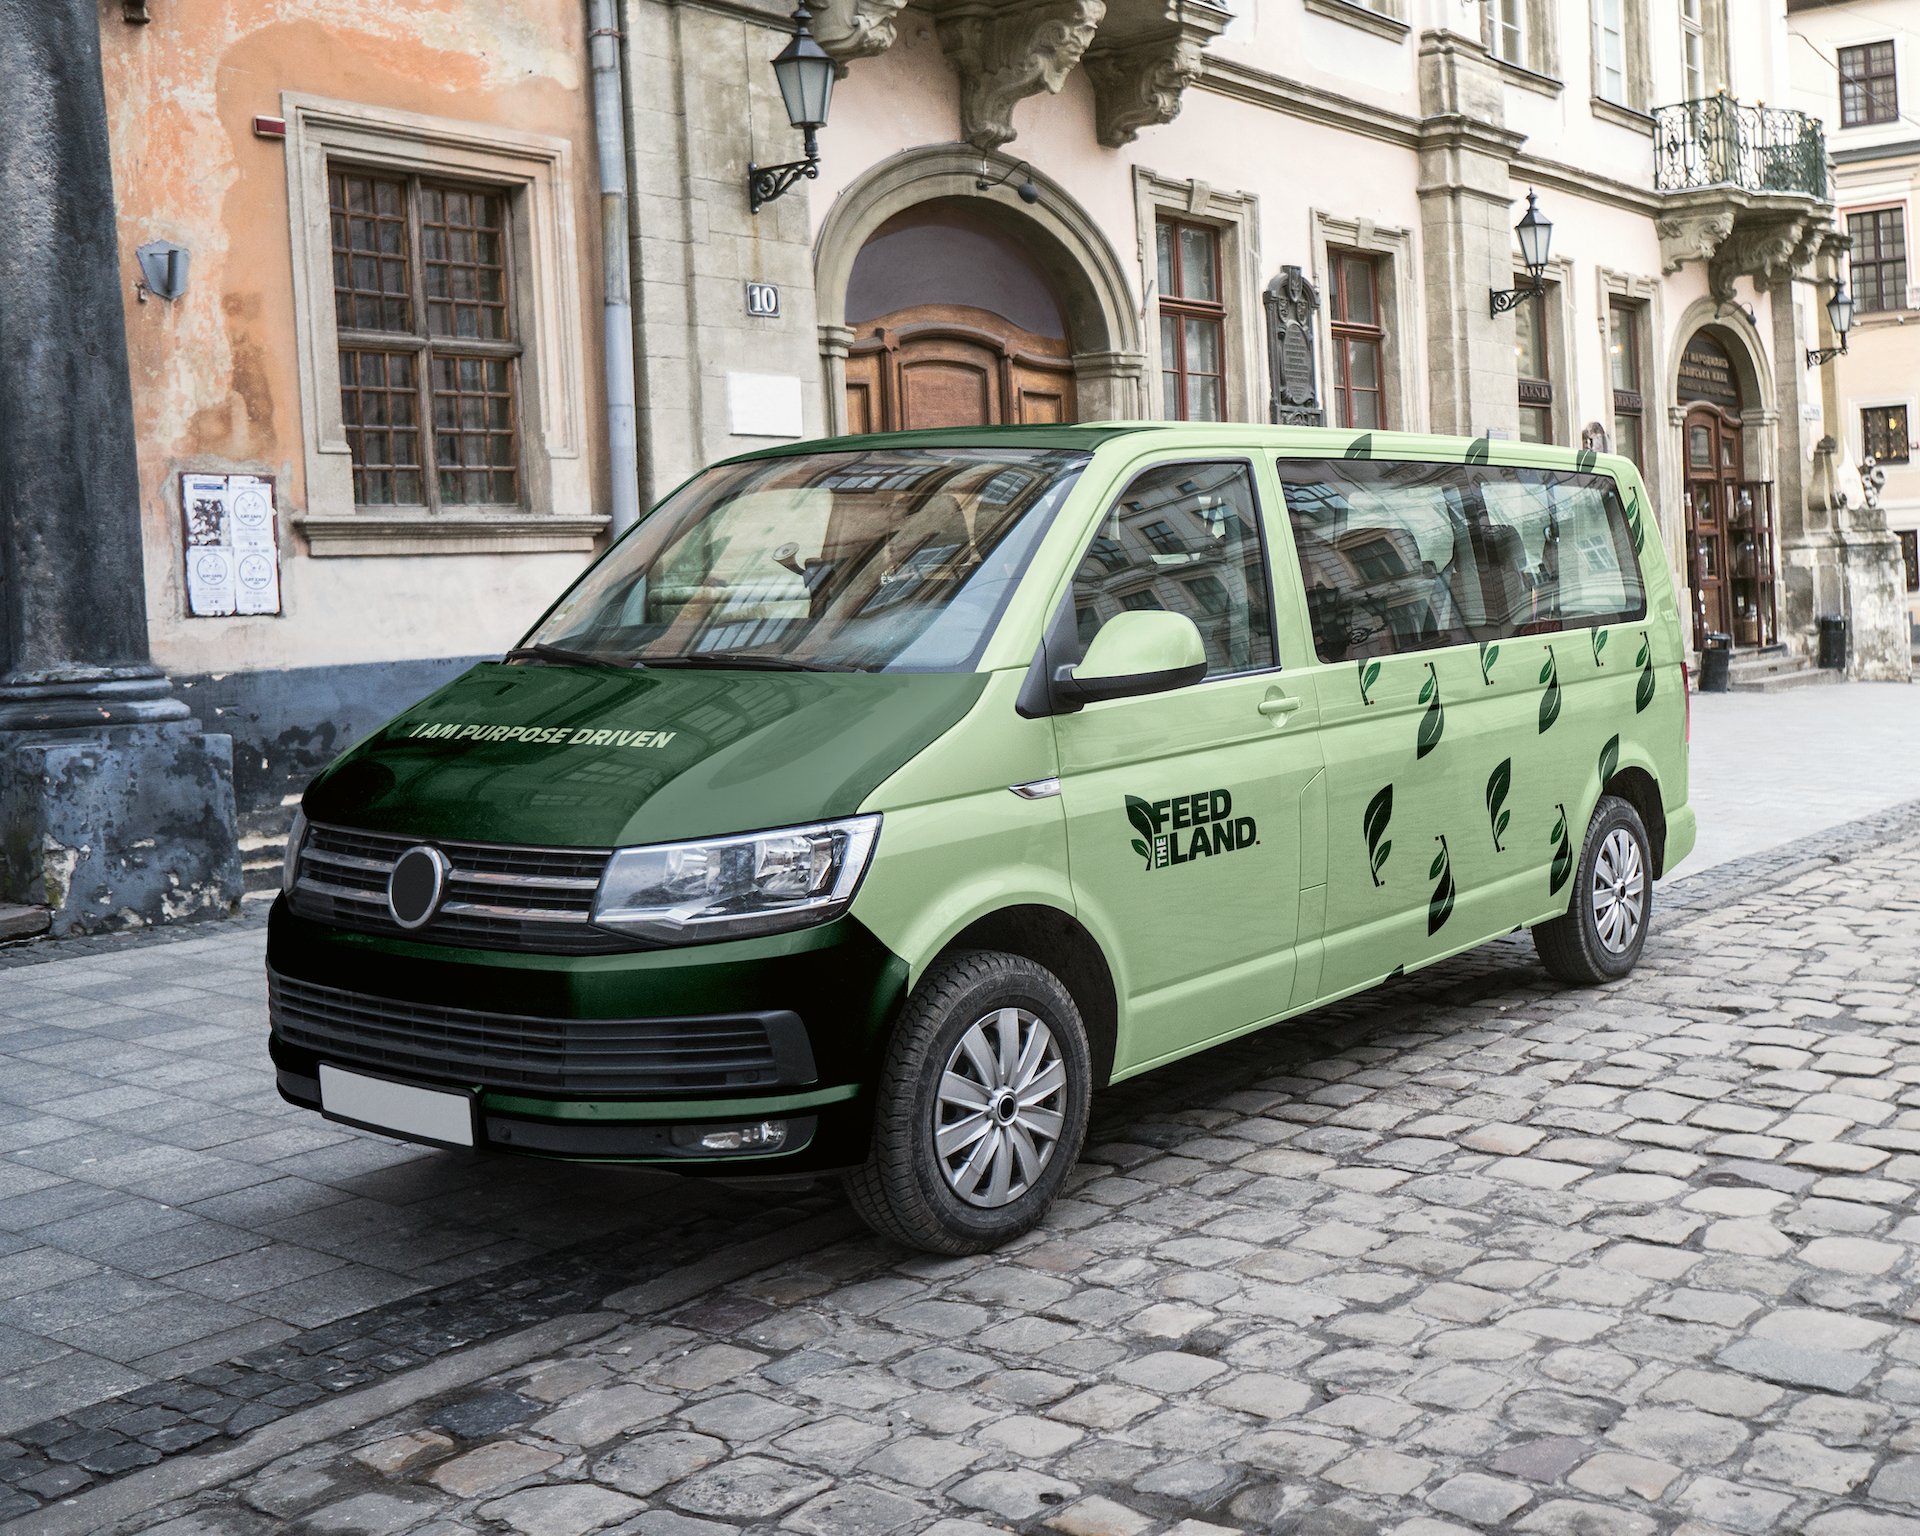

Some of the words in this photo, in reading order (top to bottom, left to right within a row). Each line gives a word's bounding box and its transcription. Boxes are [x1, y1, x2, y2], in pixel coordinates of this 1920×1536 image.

[752, 286, 776, 312] 10
[409, 723, 427, 738] I
[418, 724, 460, 739] AM
[456, 725, 573, 743] PURPOSE
[568, 729, 676, 748] DRIVEN
[1153, 789, 1231, 834] FEED
[1156, 837, 1167, 867] THE
